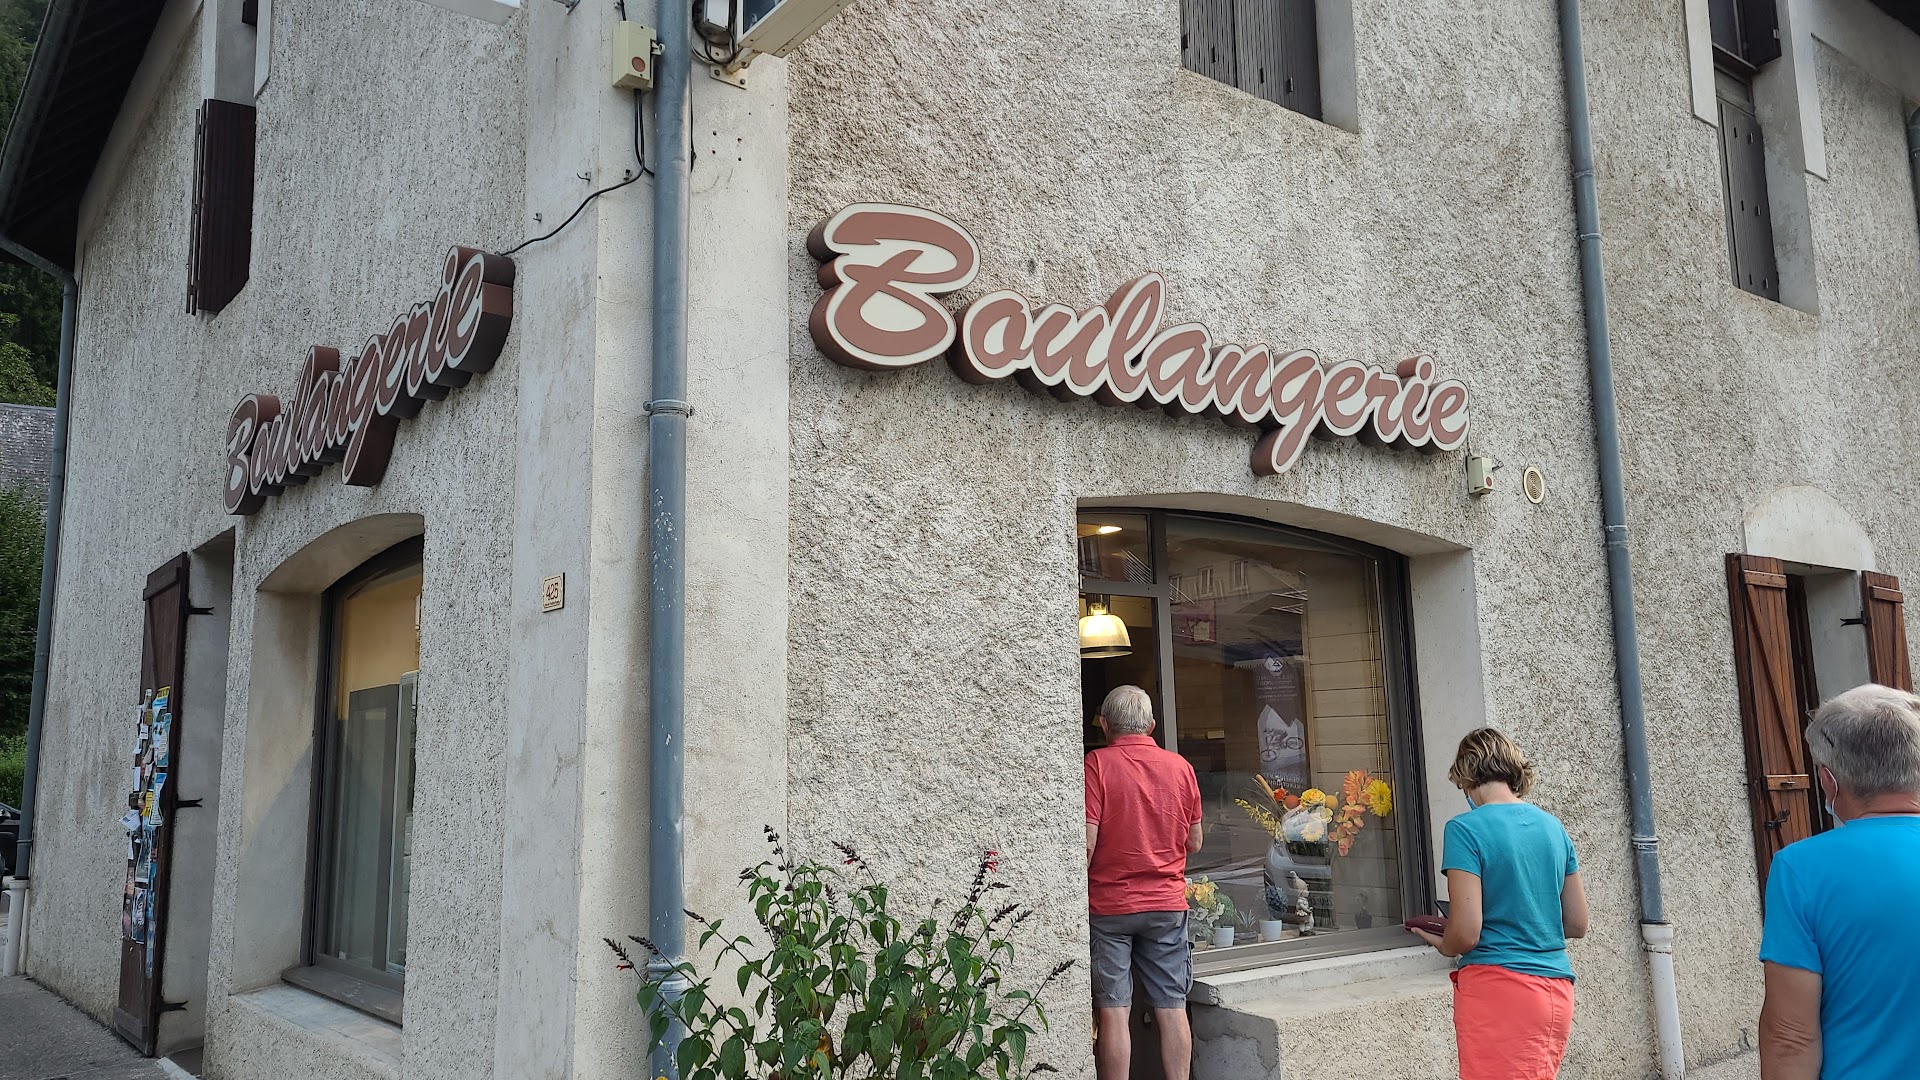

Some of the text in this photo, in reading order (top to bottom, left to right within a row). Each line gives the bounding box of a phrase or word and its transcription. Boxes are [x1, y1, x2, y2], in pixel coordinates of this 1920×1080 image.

[224, 246, 484, 515] Boulangerie
[822, 203, 1469, 475] Boulangerie
[546, 582, 559, 601] 425
